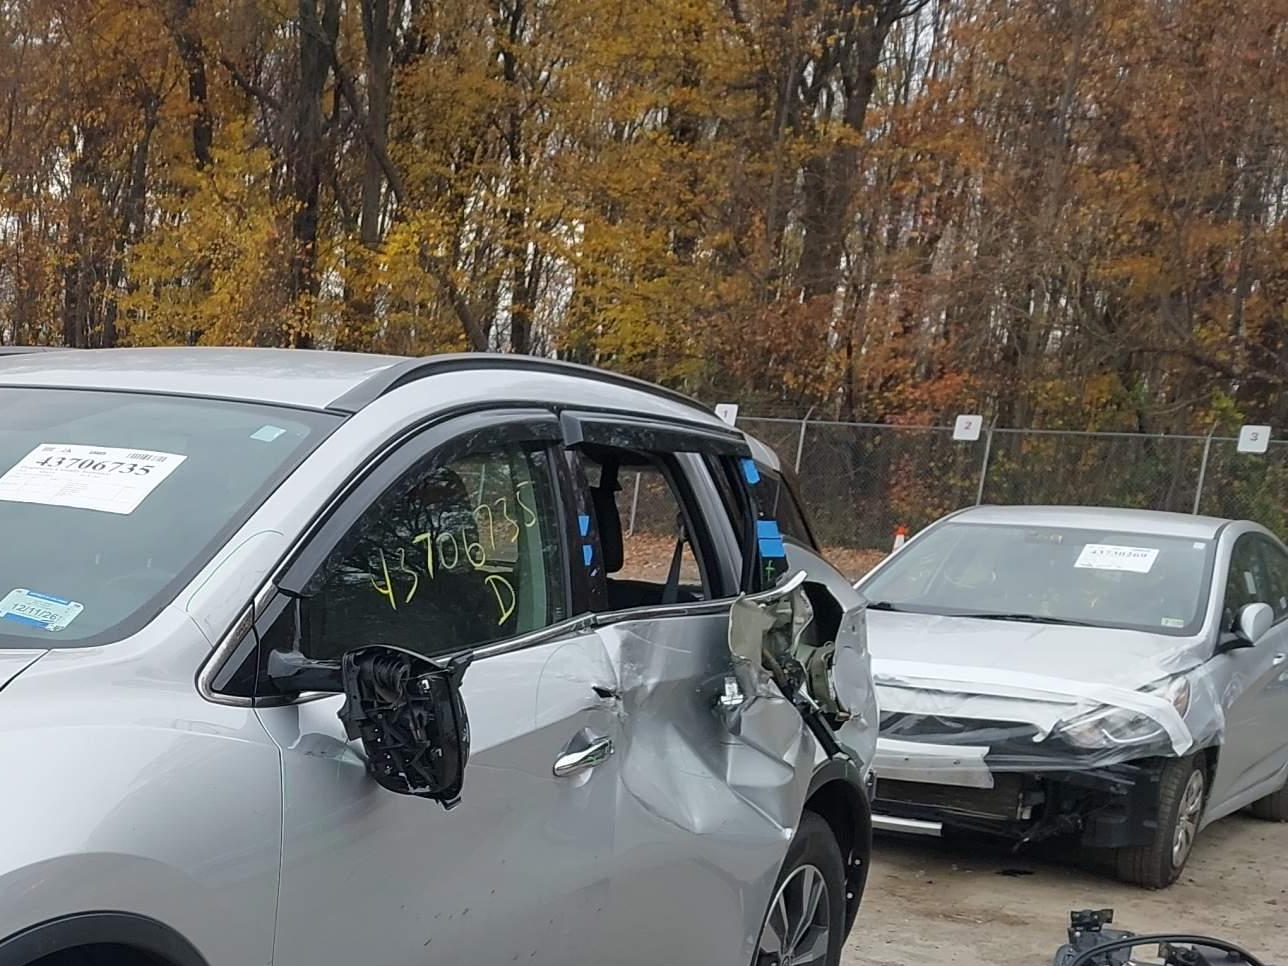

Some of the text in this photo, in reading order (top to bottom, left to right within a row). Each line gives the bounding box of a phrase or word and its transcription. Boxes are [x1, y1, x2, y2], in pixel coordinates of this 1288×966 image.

[36, 455, 156, 476] 43706735
[370, 480, 537, 611] 43706735
[485, 574, 516, 626] D
